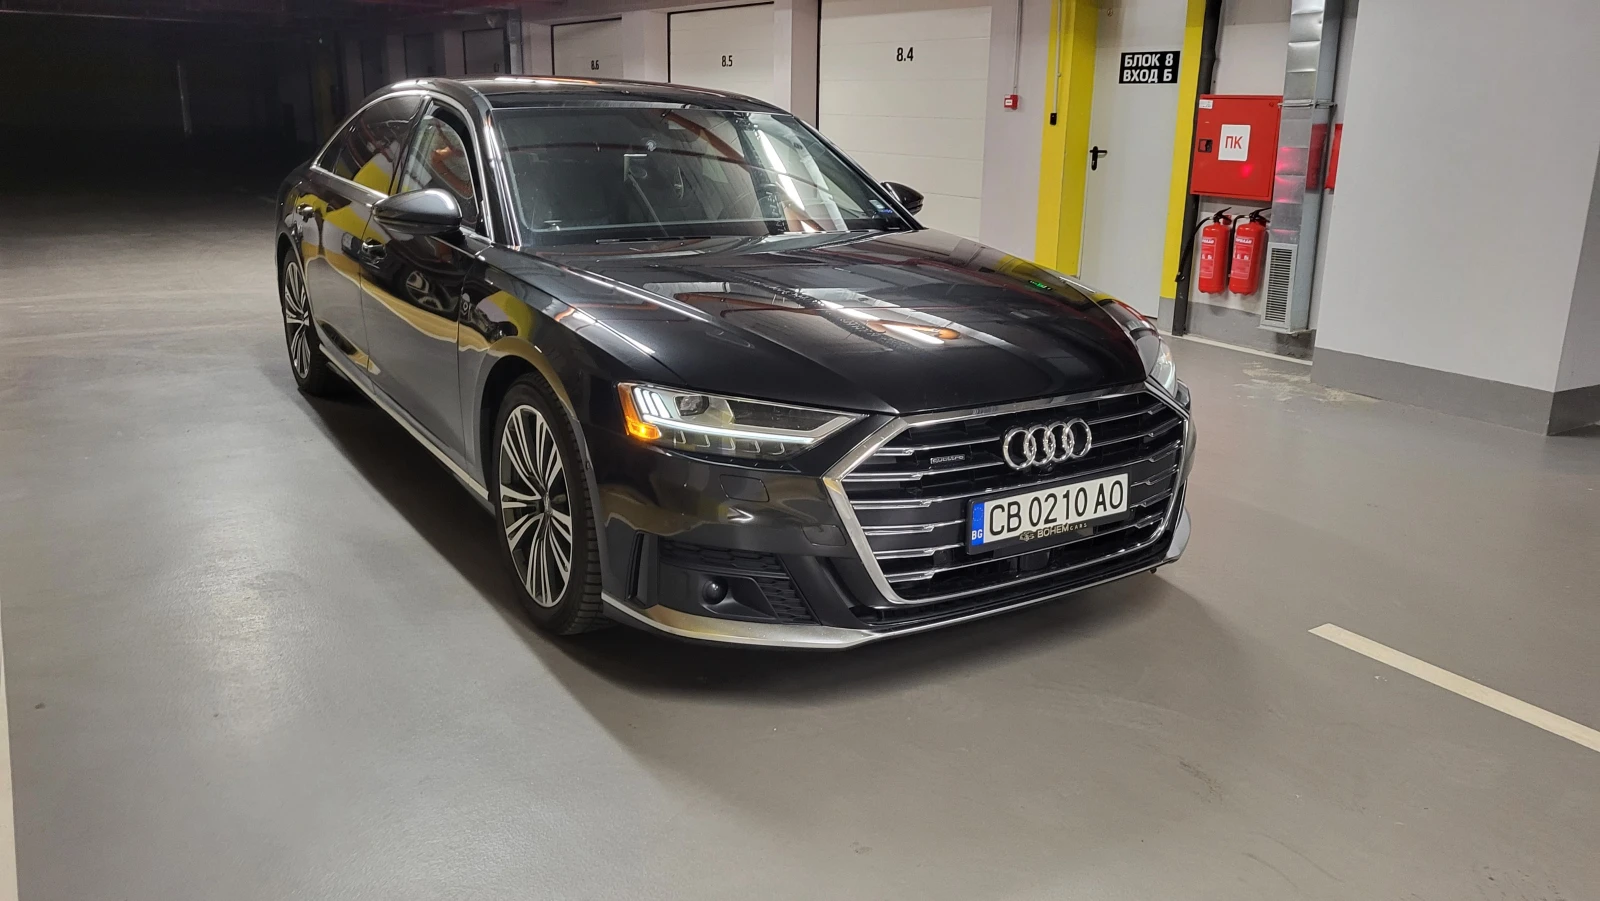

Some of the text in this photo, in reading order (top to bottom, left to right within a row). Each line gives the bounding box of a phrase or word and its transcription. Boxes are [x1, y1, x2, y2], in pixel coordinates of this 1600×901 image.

[721, 55, 733, 67] 8.5
[896, 47, 914, 62] 8.4
[1124, 53, 1174, 67] БЛОК 8
[590, 60, 600, 70] 8.6
[1123, 68, 1173, 83] ВХОД Б
[1224, 135, 1244, 149] ПК
[989, 480, 1124, 536] CB 0210 AO
[971, 529, 984, 540] BG
[1037, 522, 1088, 538] BOHEM CARS
